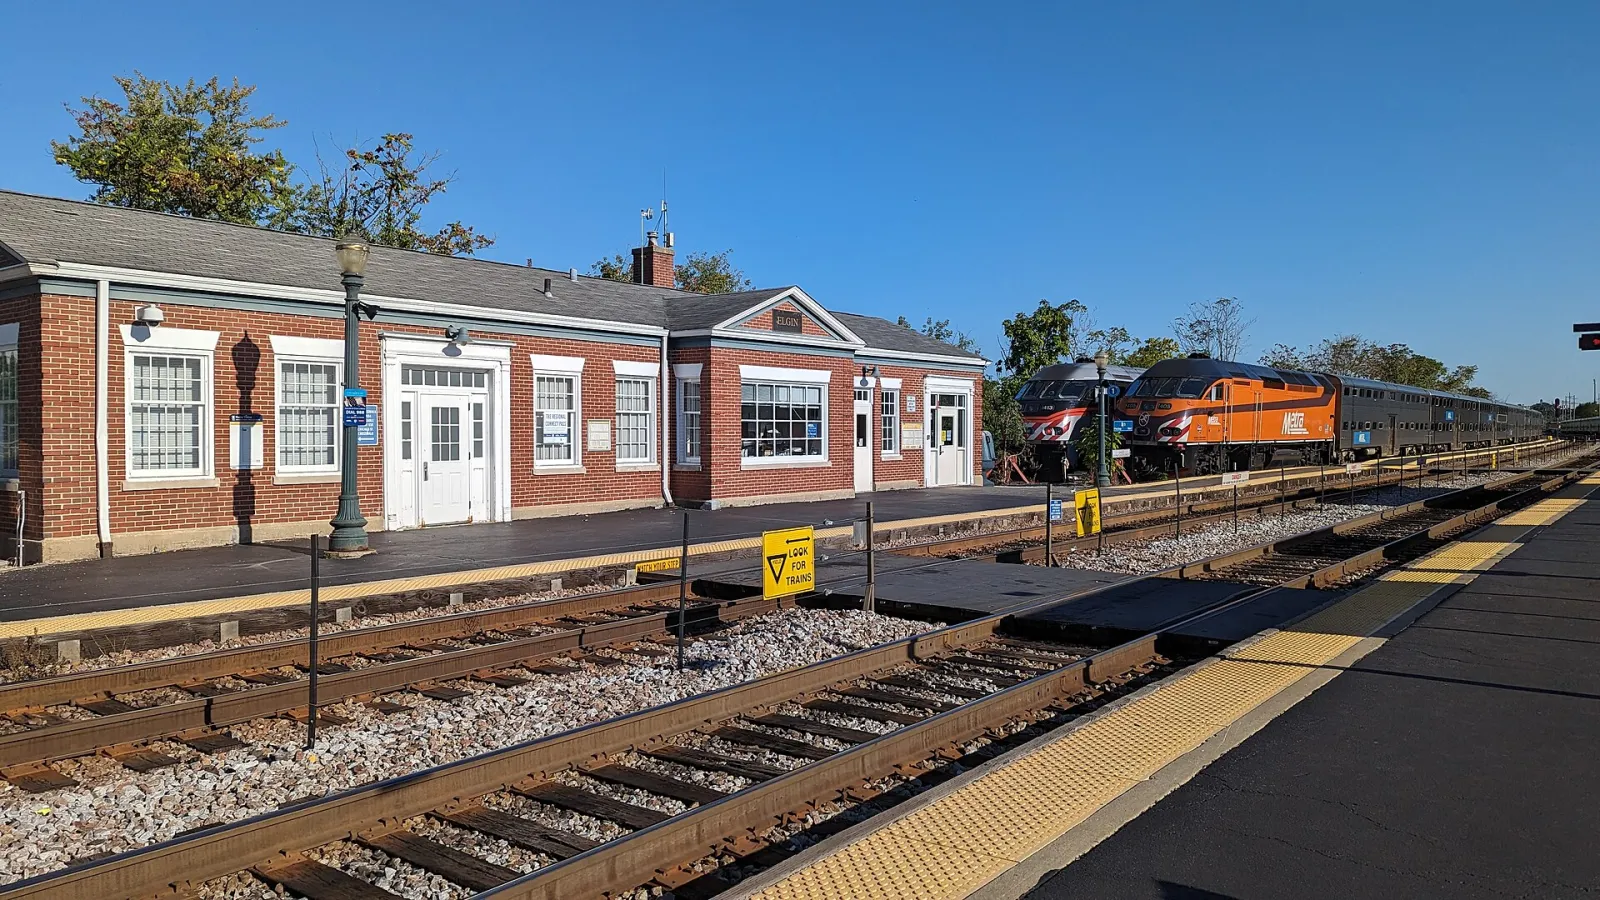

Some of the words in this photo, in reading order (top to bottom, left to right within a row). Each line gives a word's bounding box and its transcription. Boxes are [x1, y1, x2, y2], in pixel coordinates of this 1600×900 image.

[776, 316, 799, 327] ELGIN
[1281, 410, 1305, 435] Metra
[788, 546, 809, 558] LOOK
[667, 559, 679, 569] STEP
[791, 560, 806, 571] FOR
[785, 572, 812, 586] TRAINS
